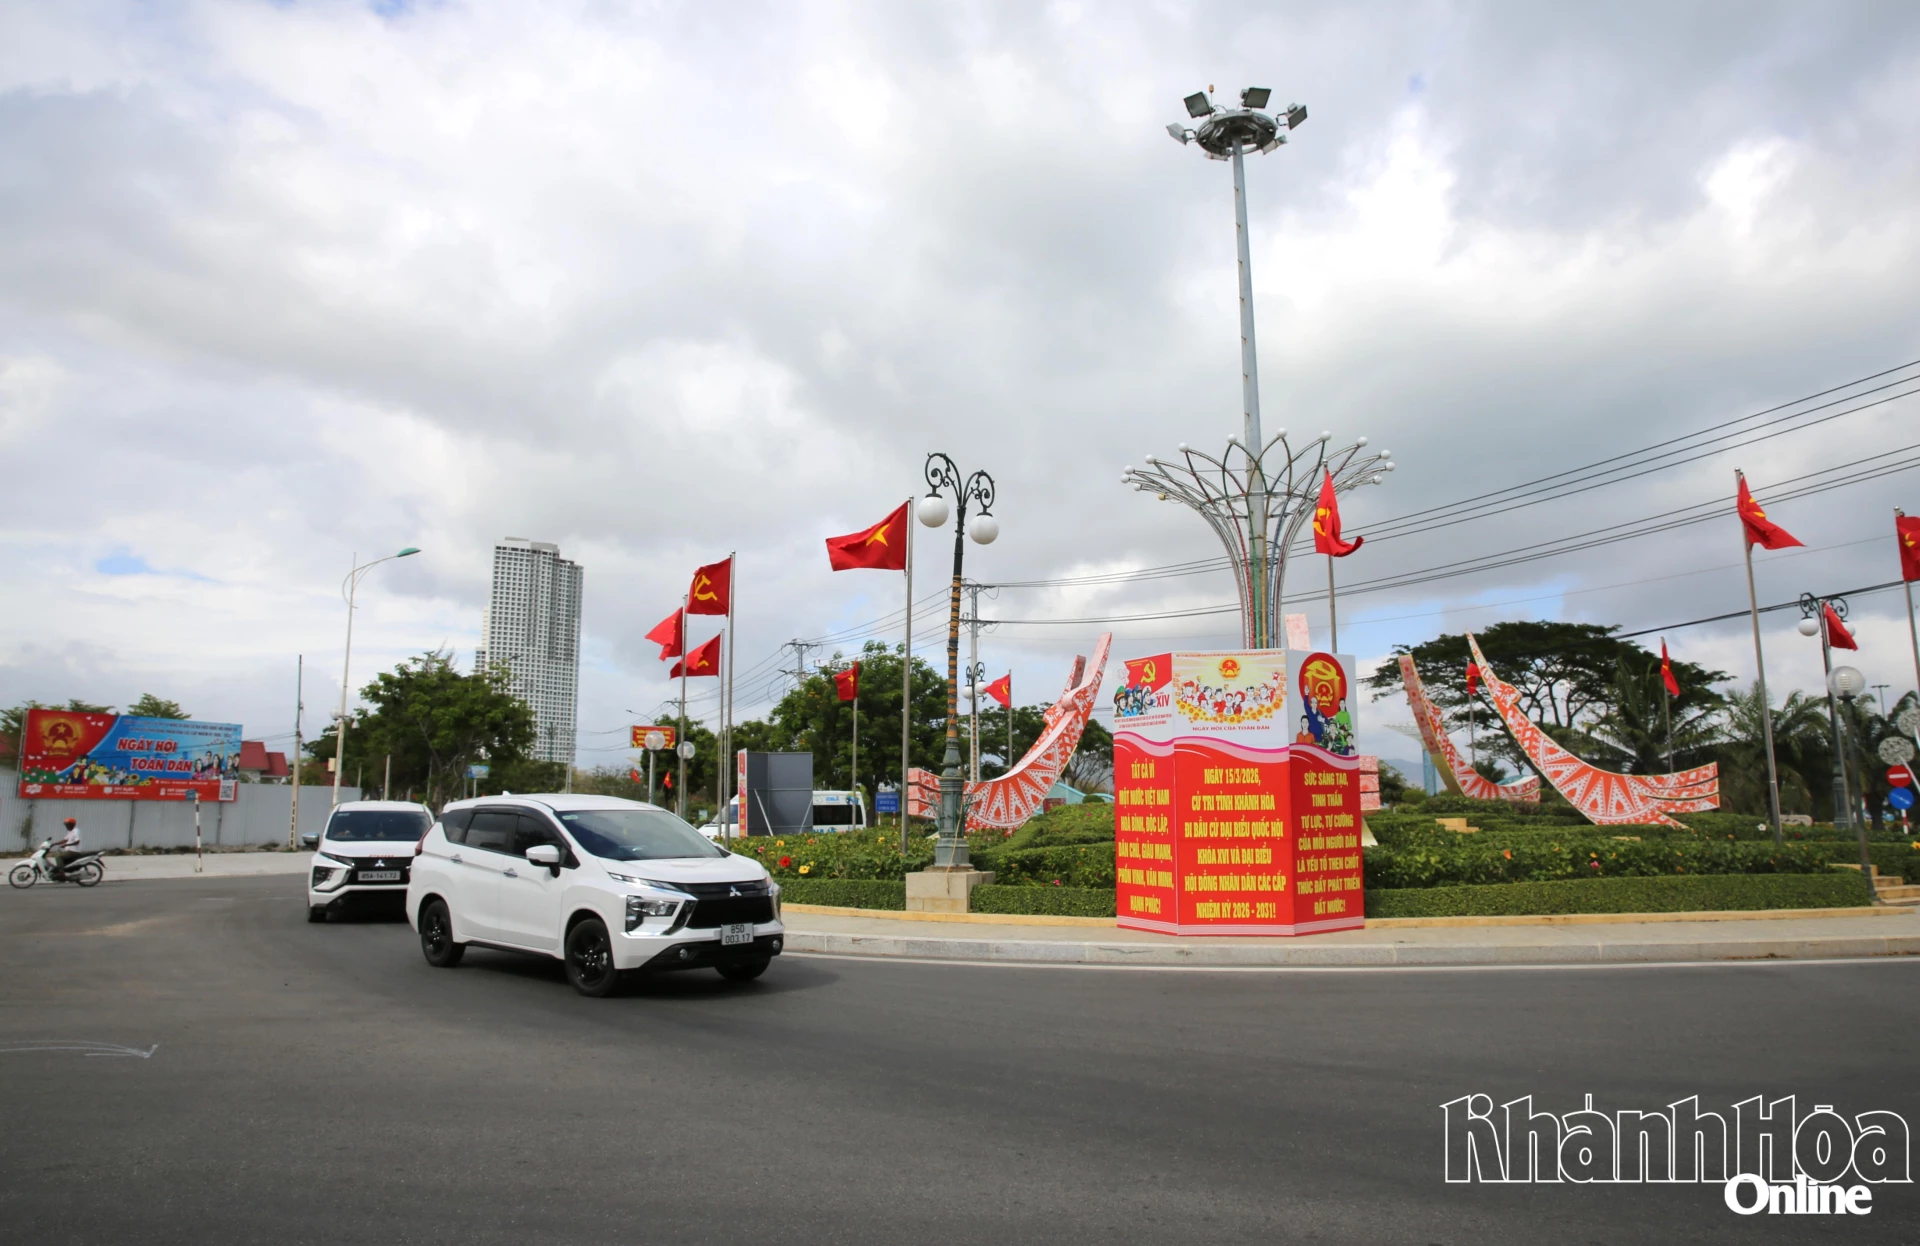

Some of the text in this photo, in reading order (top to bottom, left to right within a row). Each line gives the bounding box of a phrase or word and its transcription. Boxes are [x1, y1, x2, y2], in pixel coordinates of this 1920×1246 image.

[1157, 694, 1169, 707] XIV
[117, 734, 178, 756] NGÀY HỘI
[130, 754, 193, 772] TOÀN DÂN
[1132, 758, 1155, 778] TẤT CẢ VÌ
[1204, 766, 1261, 786] NGÀY 15/3/2026,
[1304, 770, 1348, 787] SỨC SÁNG TẠO,
[1119, 787, 1169, 809] MỘT NƯỚC VIỆT NAM
[1192, 791, 1275, 810] CỬ TRI TỈNH KHÁNH HÒA
[1312, 794, 1326, 806] TINH
[1132, 814, 1145, 834] BÌNH,
[1146, 814, 1156, 835] ĐỘC
[1158, 814, 1168, 836] LẬP,
[1185, 815, 1283, 840] ĐI BẦU CỬ ĐẠI BIỂU QUỐC HỘI
[1301, 812, 1353, 831] TỰ LỰC, TỰ CƯỜNG
[1119, 838, 1172, 863] DÂN CHỦ, GIÀU MẠNH,
[1299, 833, 1356, 851] CỦA MỖI NGƯỜI DÂN
[1198, 842, 1272, 866] KHÓA XVI VÀ ĐẠI BIỂU
[1297, 852, 1359, 873] LÀ YẾU TỐ THEN CHỐT
[1132, 870, 1145, 887] VINH,
[1146, 868, 1157, 886] VĂN
[1158, 872, 1174, 890] MINH,
[1185, 870, 1286, 894] HỘI ĐỒNG NHÂN DÂN CÁC CẤP
[1297, 872, 1360, 894] THÚC ĐẨY PHÁT TRIỂN
[1130, 895, 1161, 914] HẠNH PHÚC!
[1196, 900, 1220, 921] NHIỆM
[1222, 900, 1232, 918] KỲ
[1233, 903, 1250, 918] 2026
[1256, 903, 1276, 918] 2031!
[1314, 897, 1345, 915] ĐẤT NƯỚC!
[725, 934, 750, 943] 003.17
